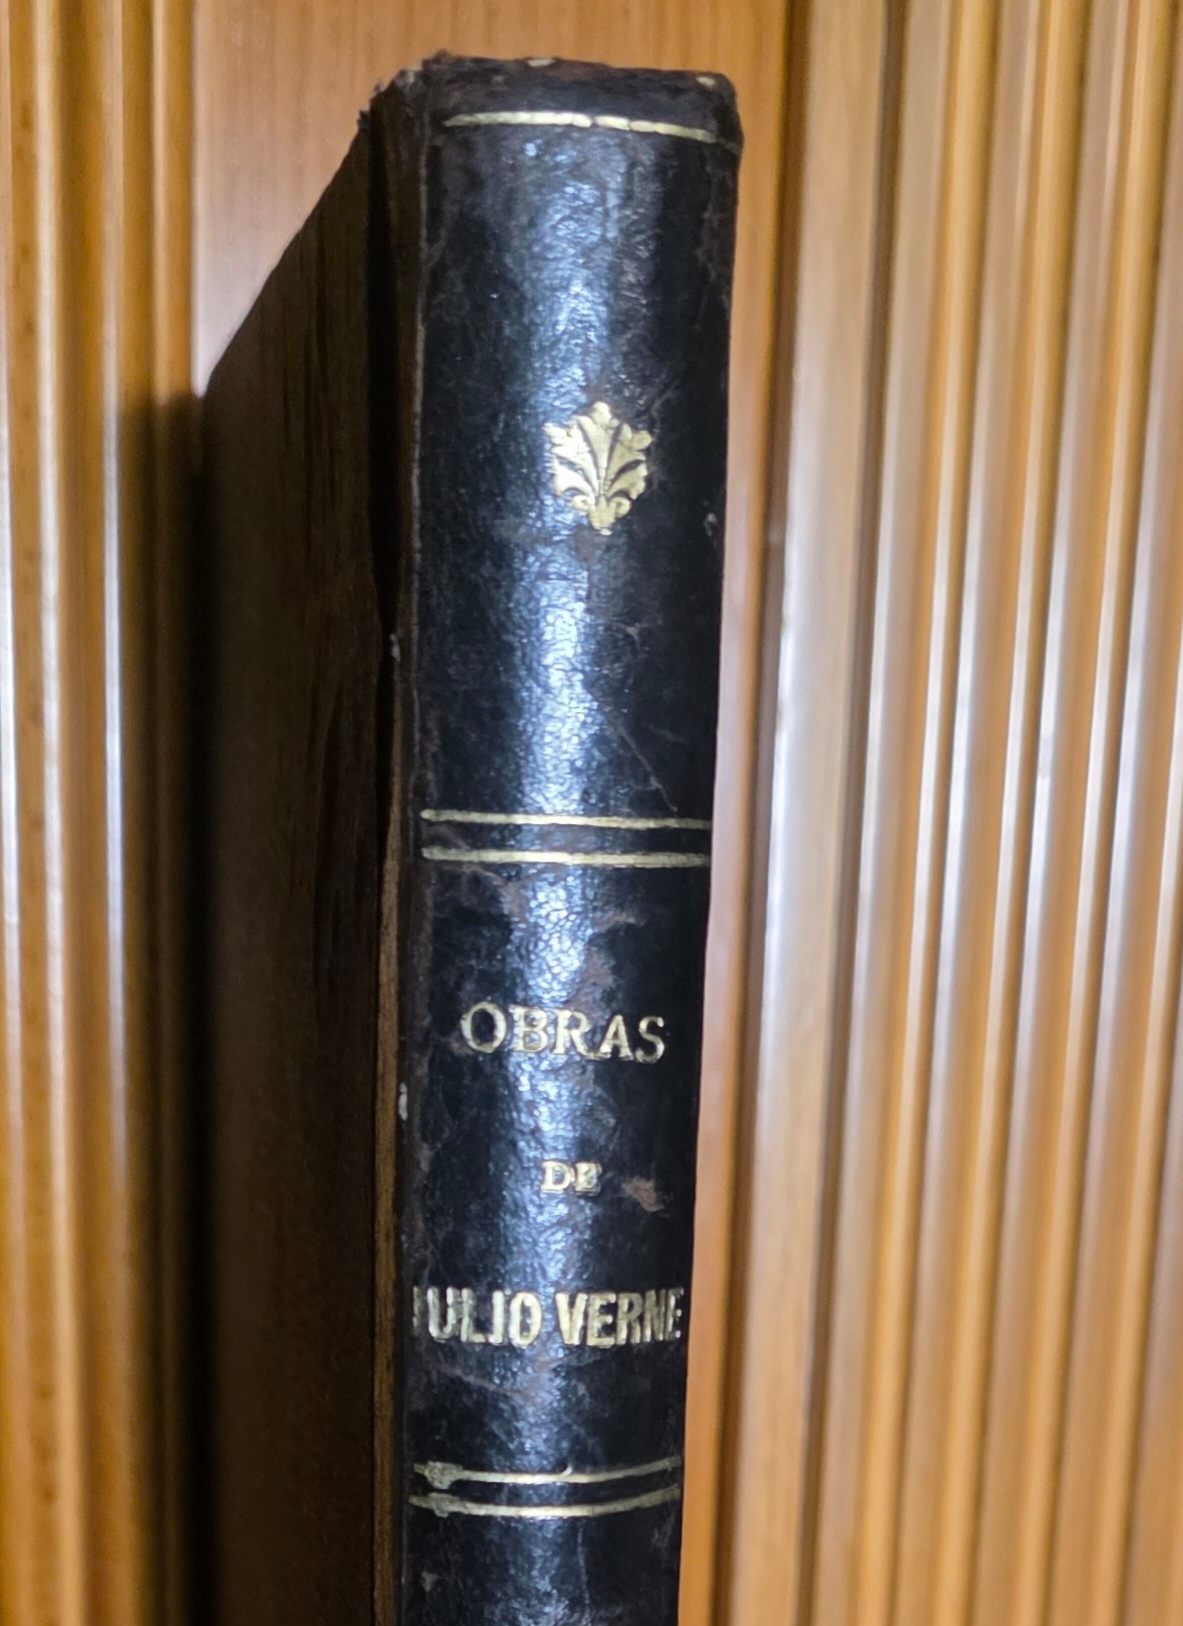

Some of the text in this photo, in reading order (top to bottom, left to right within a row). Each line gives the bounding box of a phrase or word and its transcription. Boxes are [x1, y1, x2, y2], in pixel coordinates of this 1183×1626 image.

[460, 1001, 665, 1063] OBRAS
[541, 1159, 602, 1193] DE
[555, 1288, 684, 1348] VERNE
